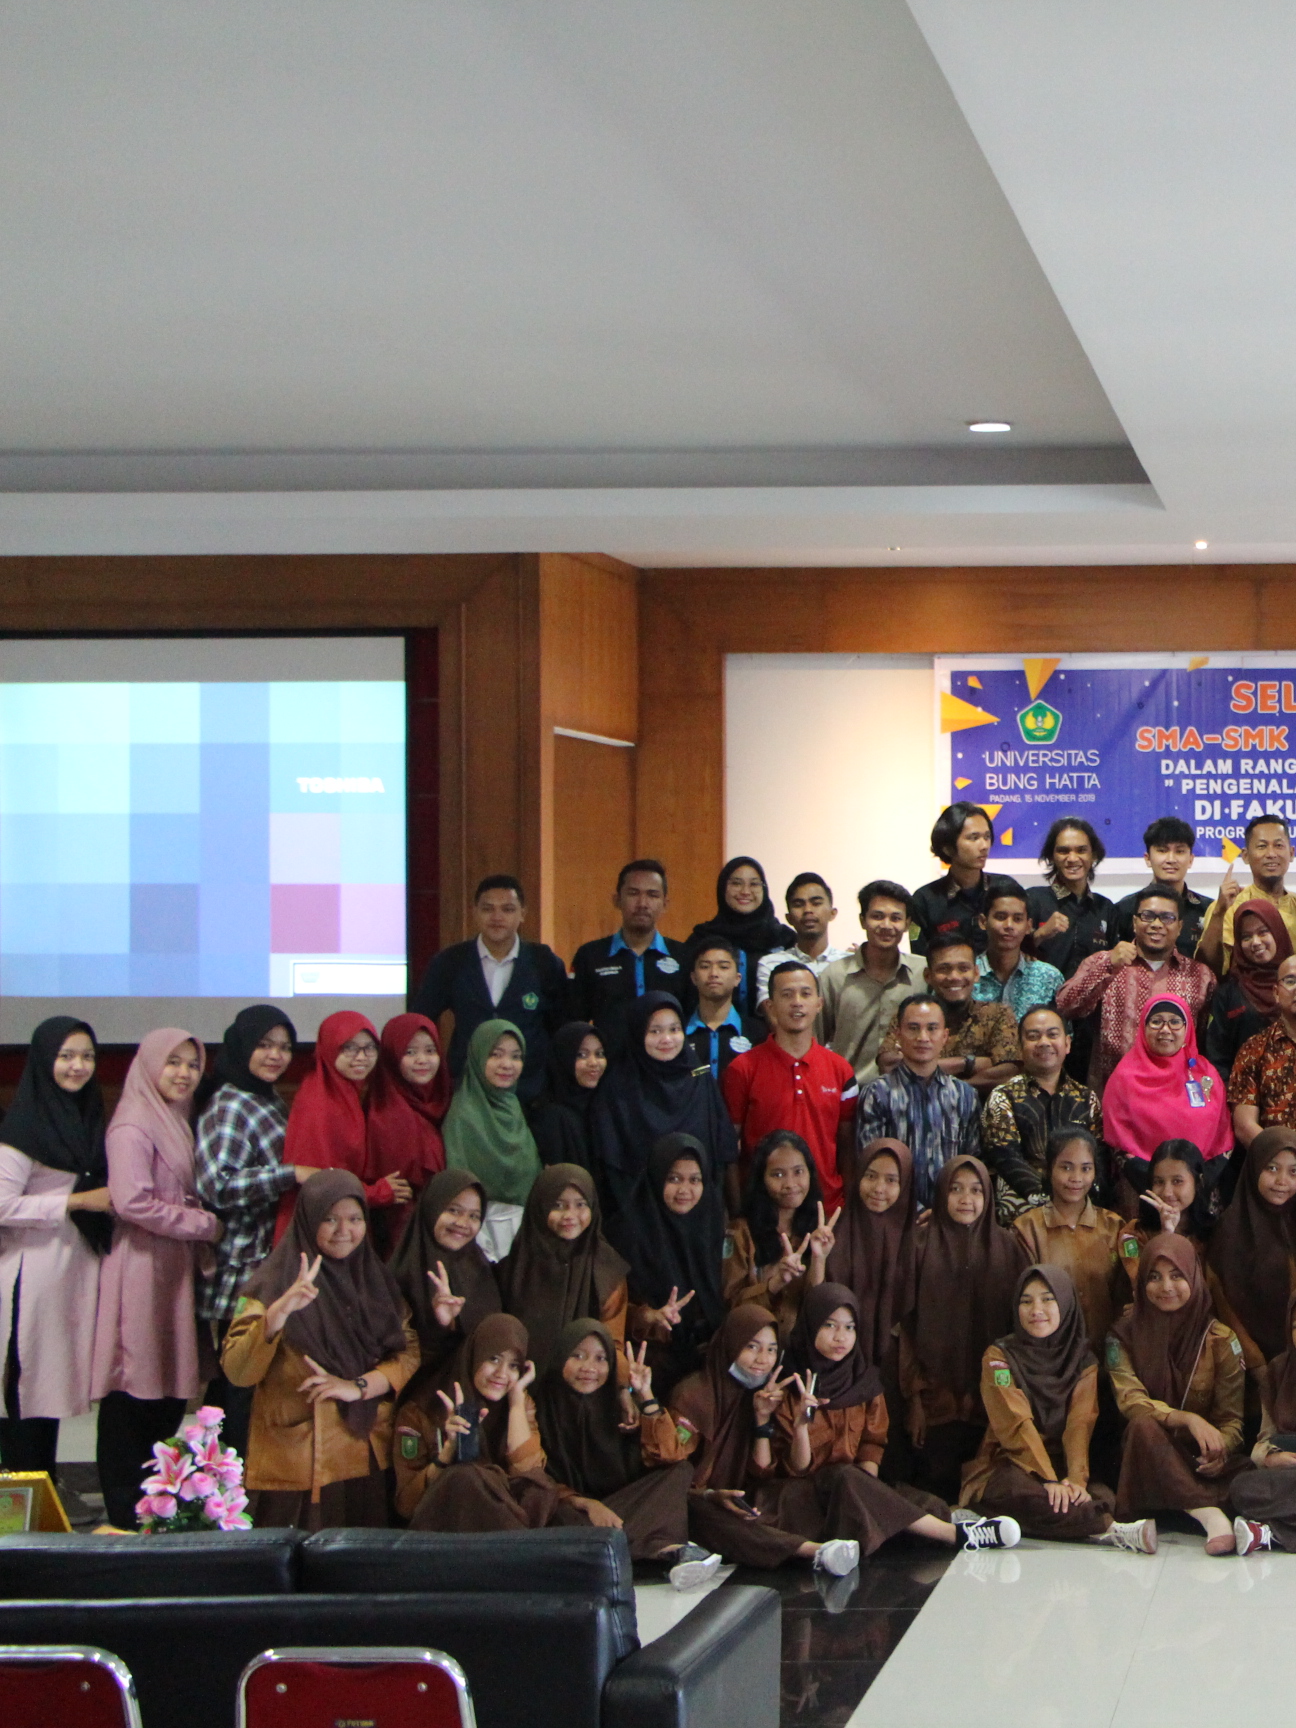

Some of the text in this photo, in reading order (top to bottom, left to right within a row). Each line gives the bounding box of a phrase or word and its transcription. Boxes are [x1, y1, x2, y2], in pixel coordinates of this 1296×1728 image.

[1136, 726, 1288, 751] SMA-SMK
[985, 750, 1100, 767] UNIVERSITAS
[1161, 759, 1232, 775] DALAM
[296, 777, 385, 793] TOSHIBA
[985, 772, 1101, 789] BUNG HATTA
[1025, 794, 1033, 803] 15
[1034, 793, 1076, 803] NOVEMBER
[1078, 793, 1096, 802] 2019
[1194, 799, 1221, 820] DI
[1196, 826, 1245, 839] PROGR
